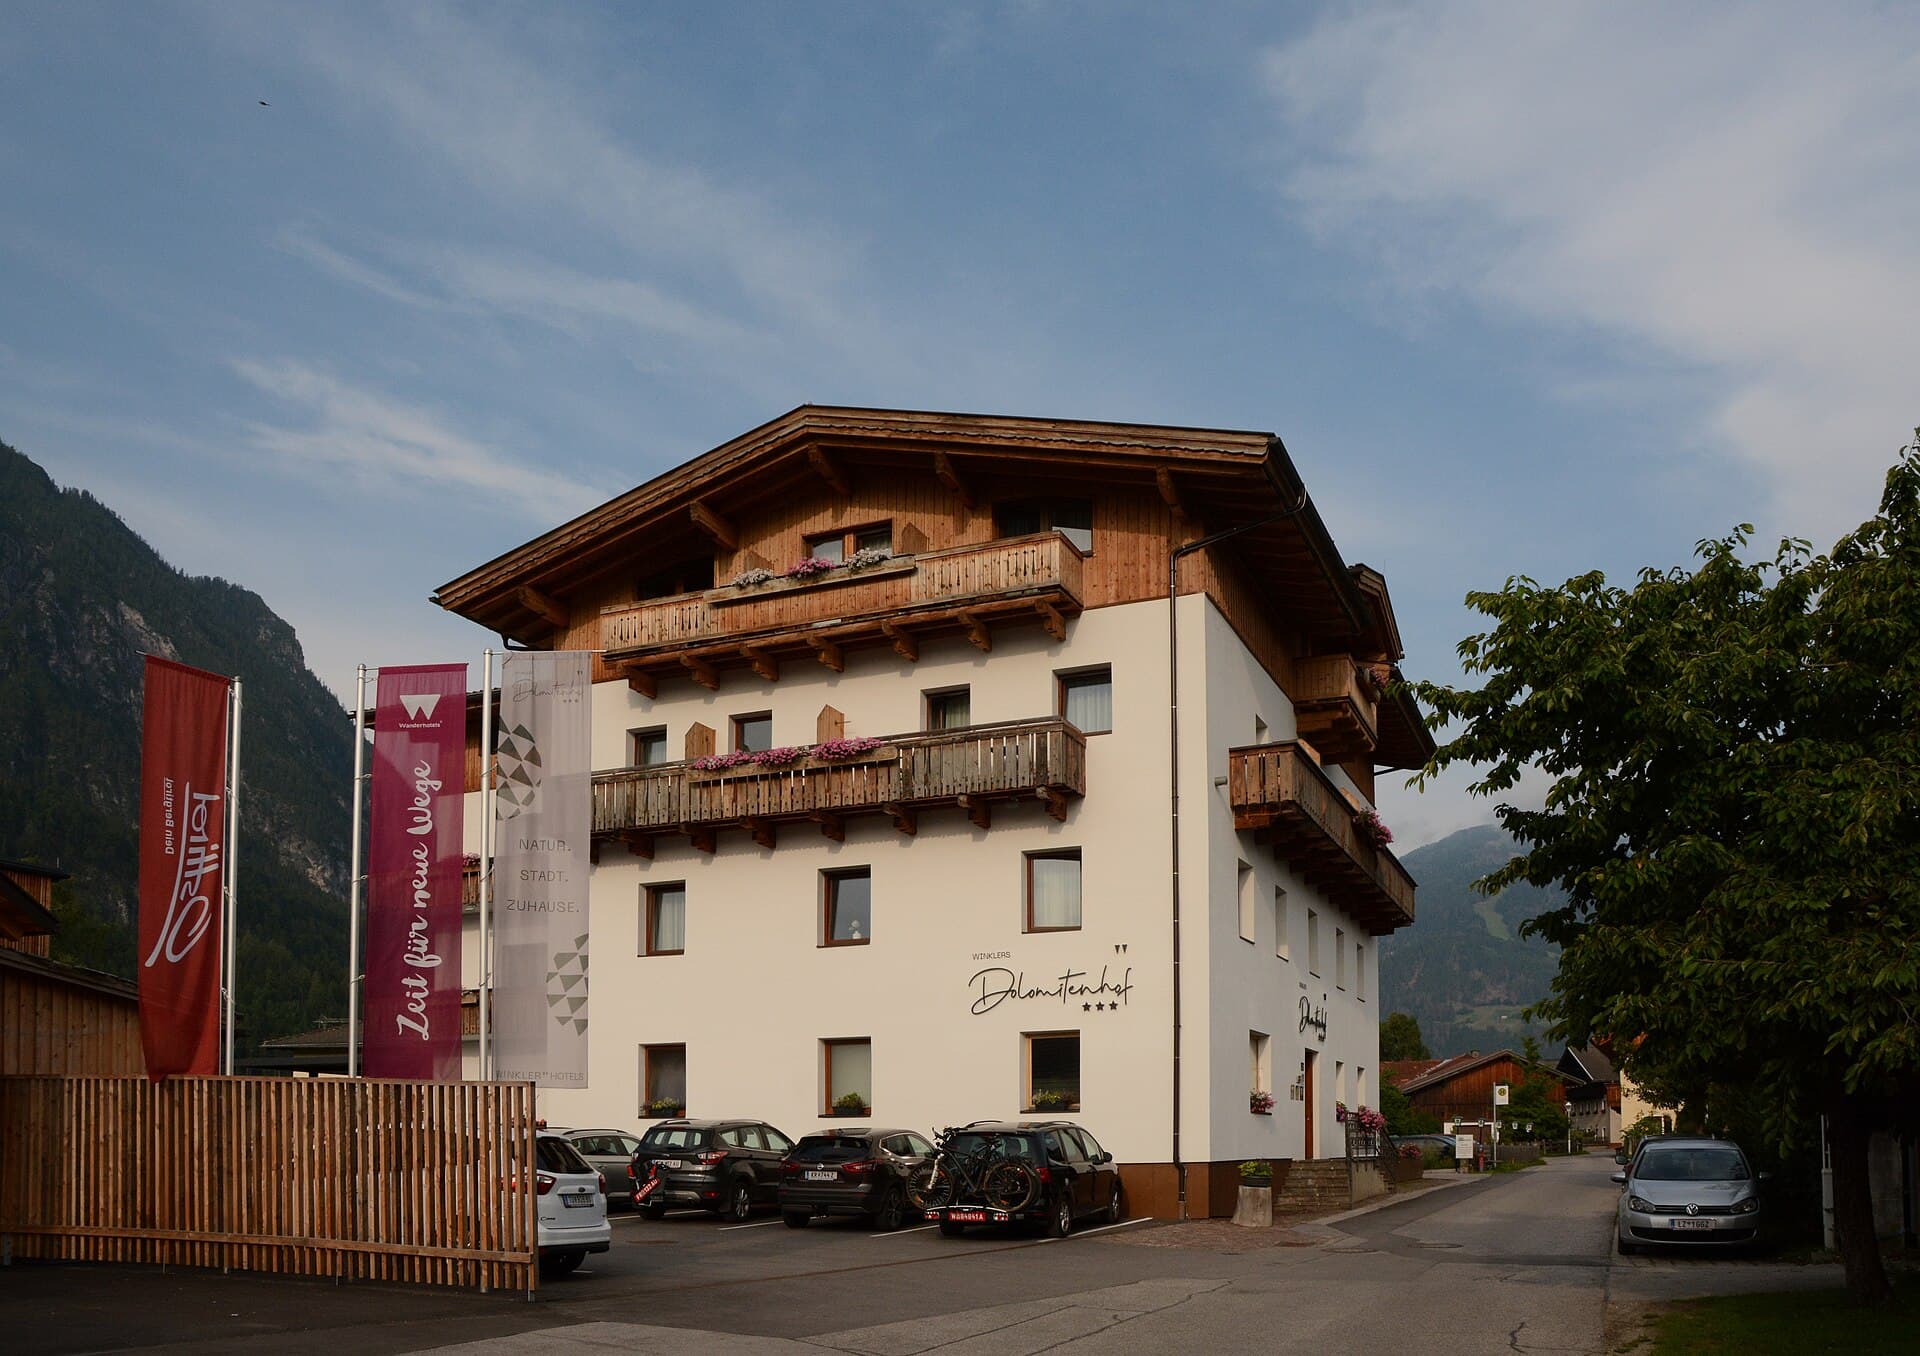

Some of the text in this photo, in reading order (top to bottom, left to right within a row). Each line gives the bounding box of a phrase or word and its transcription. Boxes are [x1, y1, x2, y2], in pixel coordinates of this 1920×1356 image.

[519, 839, 572, 853] NATUR.
[519, 869, 569, 882] STADT.
[396, 759, 442, 1041] Zeit für neue Wege
[506, 899, 580, 913] ZUHAUSE.
[972, 951, 1011, 961] WINKLERS
[968, 965, 1134, 1016] Dolomitenhof
